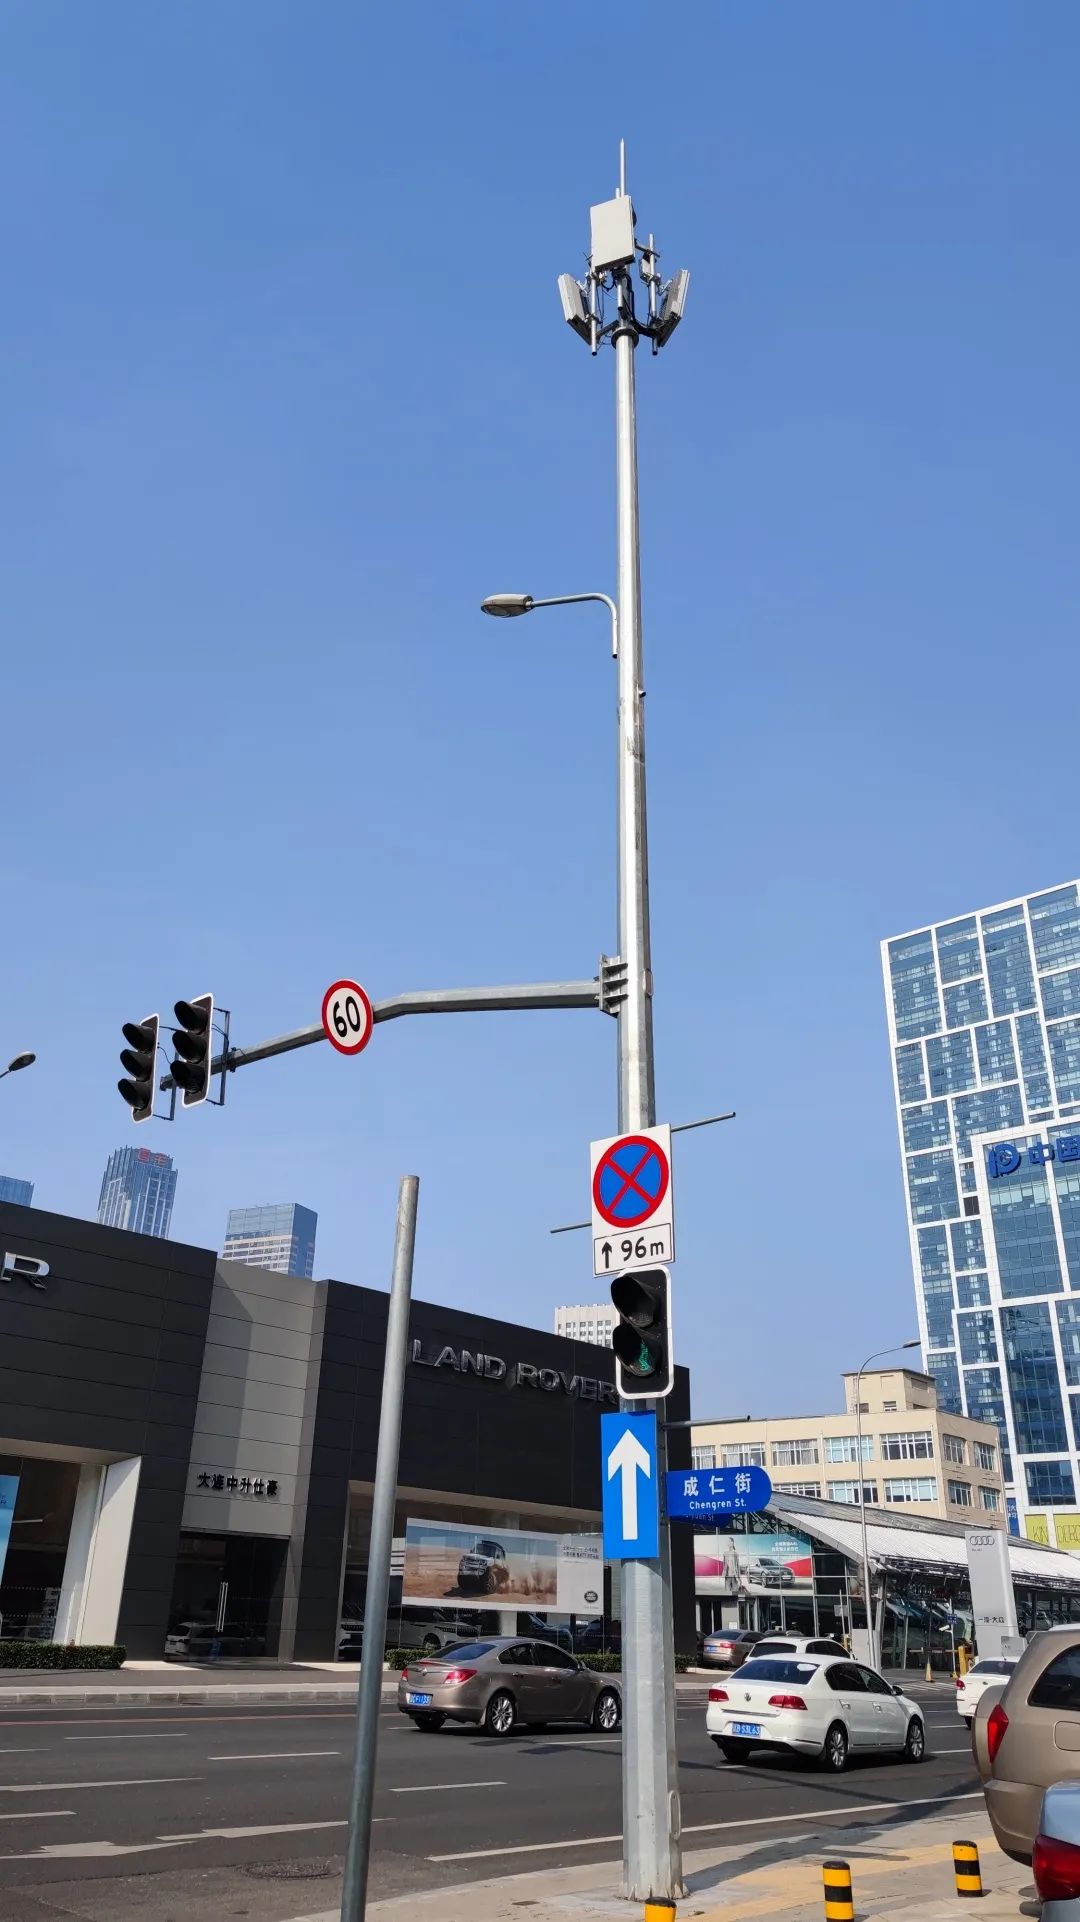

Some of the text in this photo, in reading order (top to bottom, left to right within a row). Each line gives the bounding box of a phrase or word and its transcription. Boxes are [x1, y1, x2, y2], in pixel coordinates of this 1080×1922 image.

[333, 996, 360, 1037] 60
[621, 1237, 664, 1261] 96m
[412, 1339, 620, 1404] LAND ROVER
[683, 1473, 752, 1497] 成仁街
[689, 1498, 747, 1511] Chengren St.
